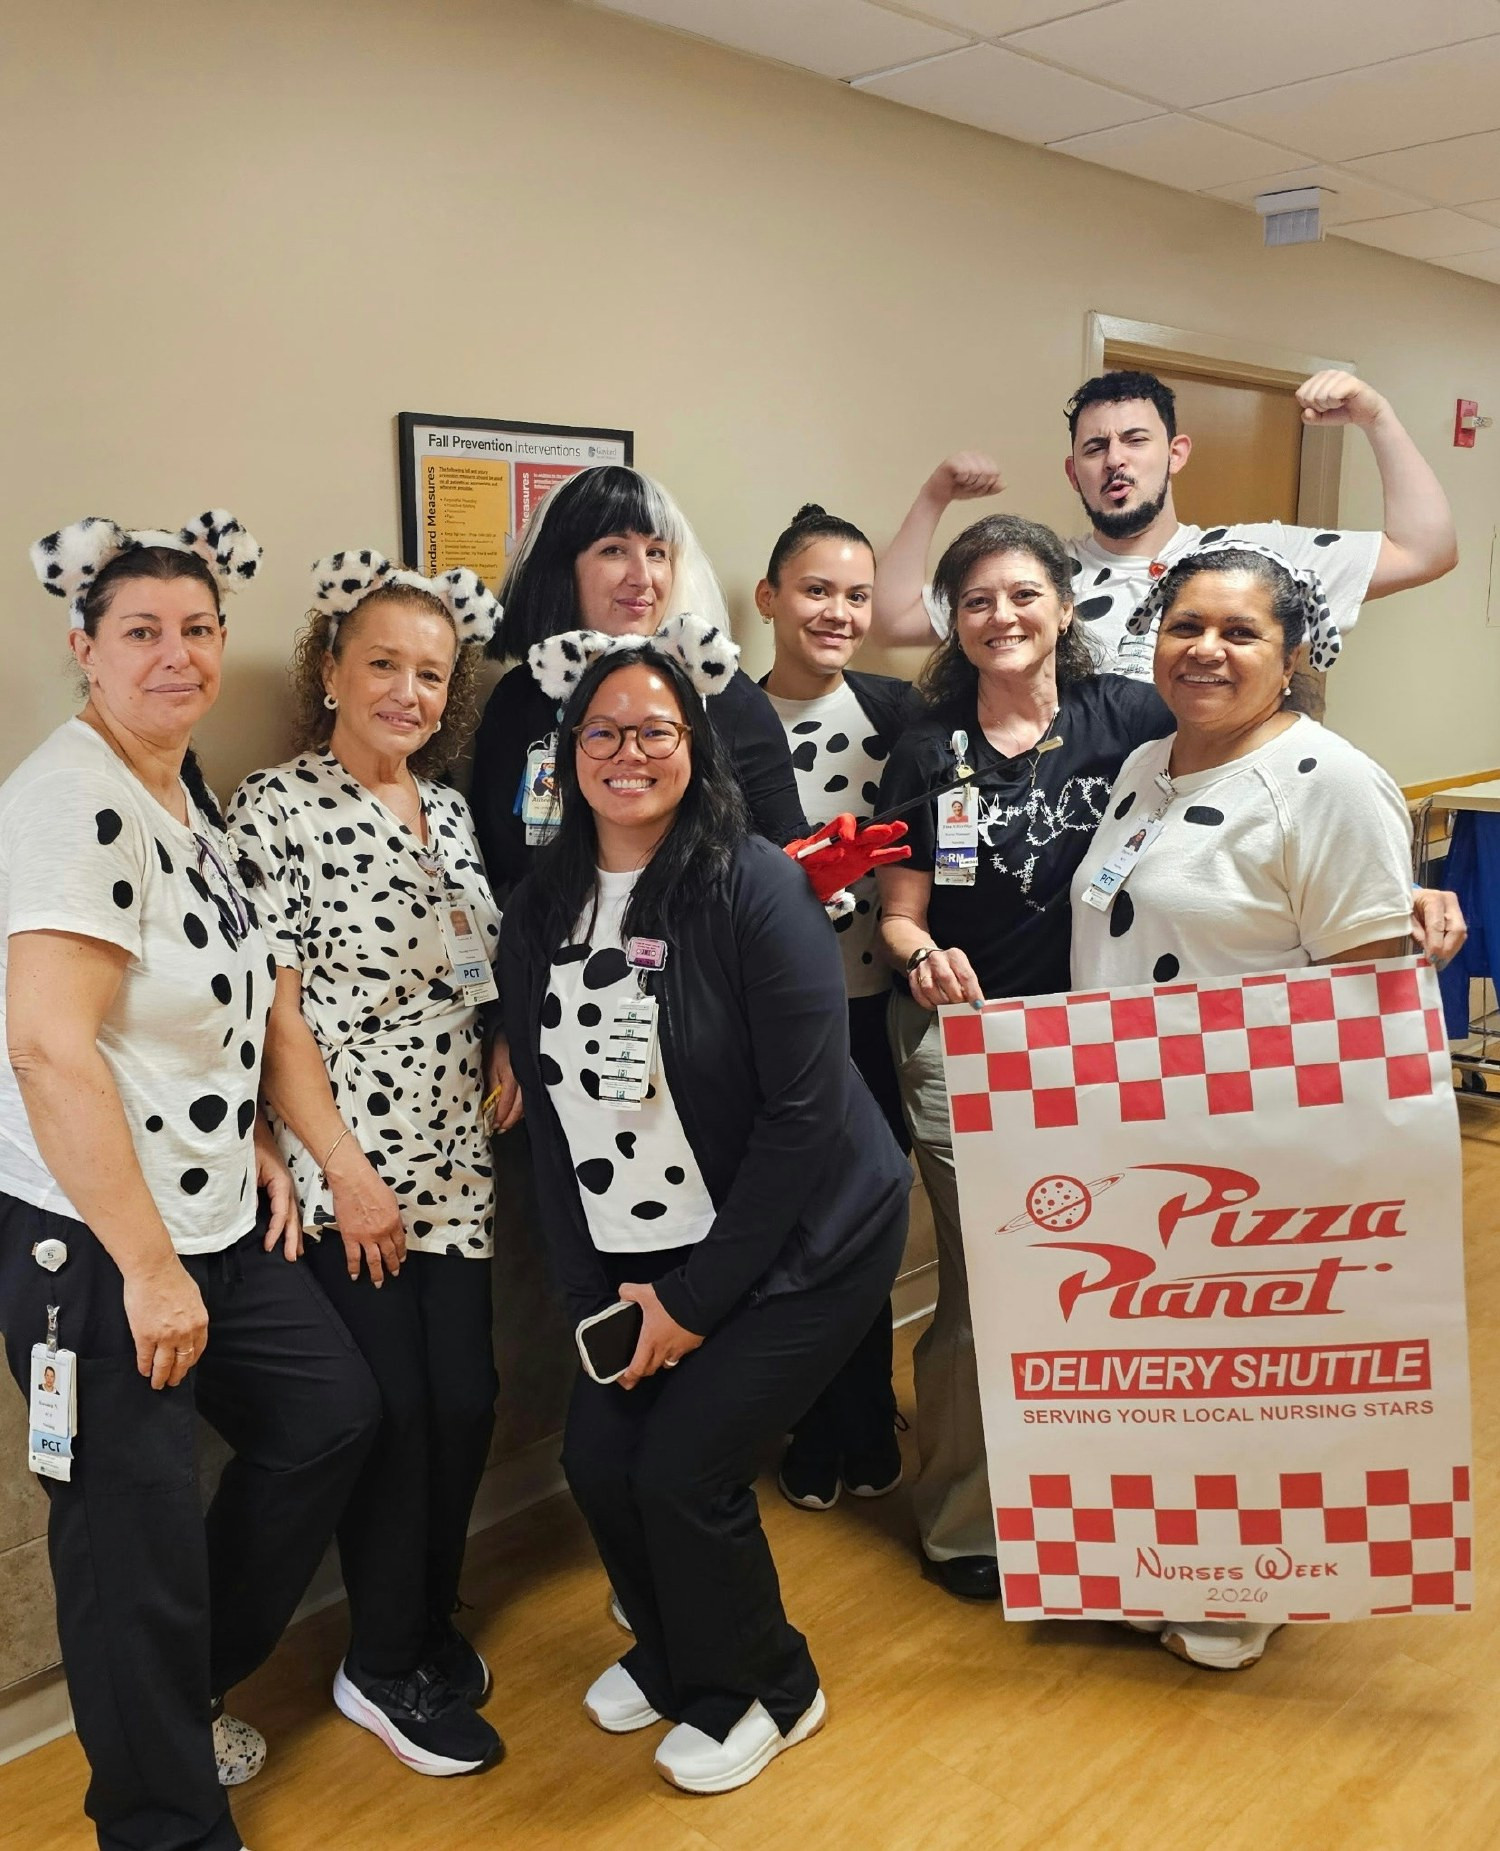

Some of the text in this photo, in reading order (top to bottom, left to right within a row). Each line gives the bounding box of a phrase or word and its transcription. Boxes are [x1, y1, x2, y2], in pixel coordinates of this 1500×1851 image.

[428, 434, 581, 457] Fall Prevention Interventions
[427, 466, 437, 526] Measures
[948, 853, 965, 863] RN
[1099, 873, 1115, 886] PCT
[463, 968, 481, 979] PCT
[1126, 1162, 1408, 1249] Pizza
[1027, 1242, 1394, 1323] Planet
[1023, 1346, 1424, 1392] DELIVERY SHUTTLE
[1023, 1399, 1434, 1424] SERVING YOUR LOCAL NURSING STARS
[41, 1438, 62, 1453] PCT
